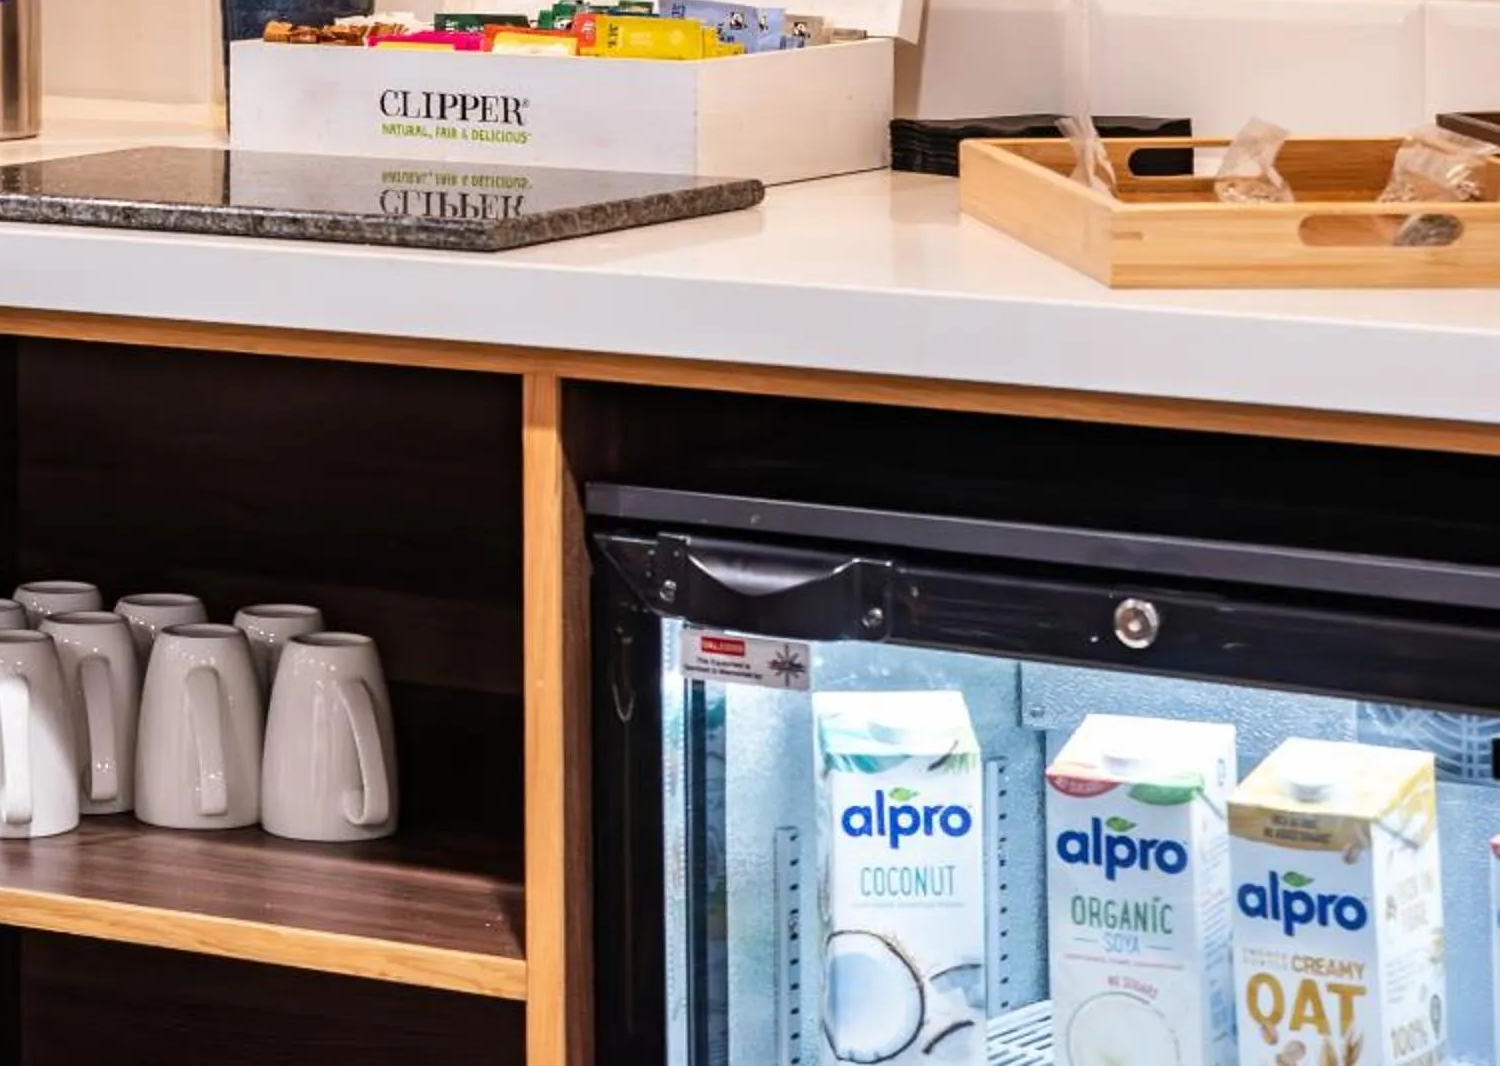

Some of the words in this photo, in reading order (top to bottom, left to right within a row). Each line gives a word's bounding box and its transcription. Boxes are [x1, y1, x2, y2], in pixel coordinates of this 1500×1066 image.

[379, 89, 524, 126] CLIPPER
[381, 123, 433, 139] NATURAL,
[435, 126, 457, 139] FAIR
[471, 129, 528, 144] DELICIOUS
[841, 789, 972, 849] alpro
[1056, 816, 1188, 882] alpro
[860, 864, 956, 897] COCONUT
[1237, 869, 1368, 936] alpro
[1102, 932, 1141, 954] SOYA
[1290, 955, 1365, 980] CREAMY
[1246, 972, 1367, 1038] OAT
